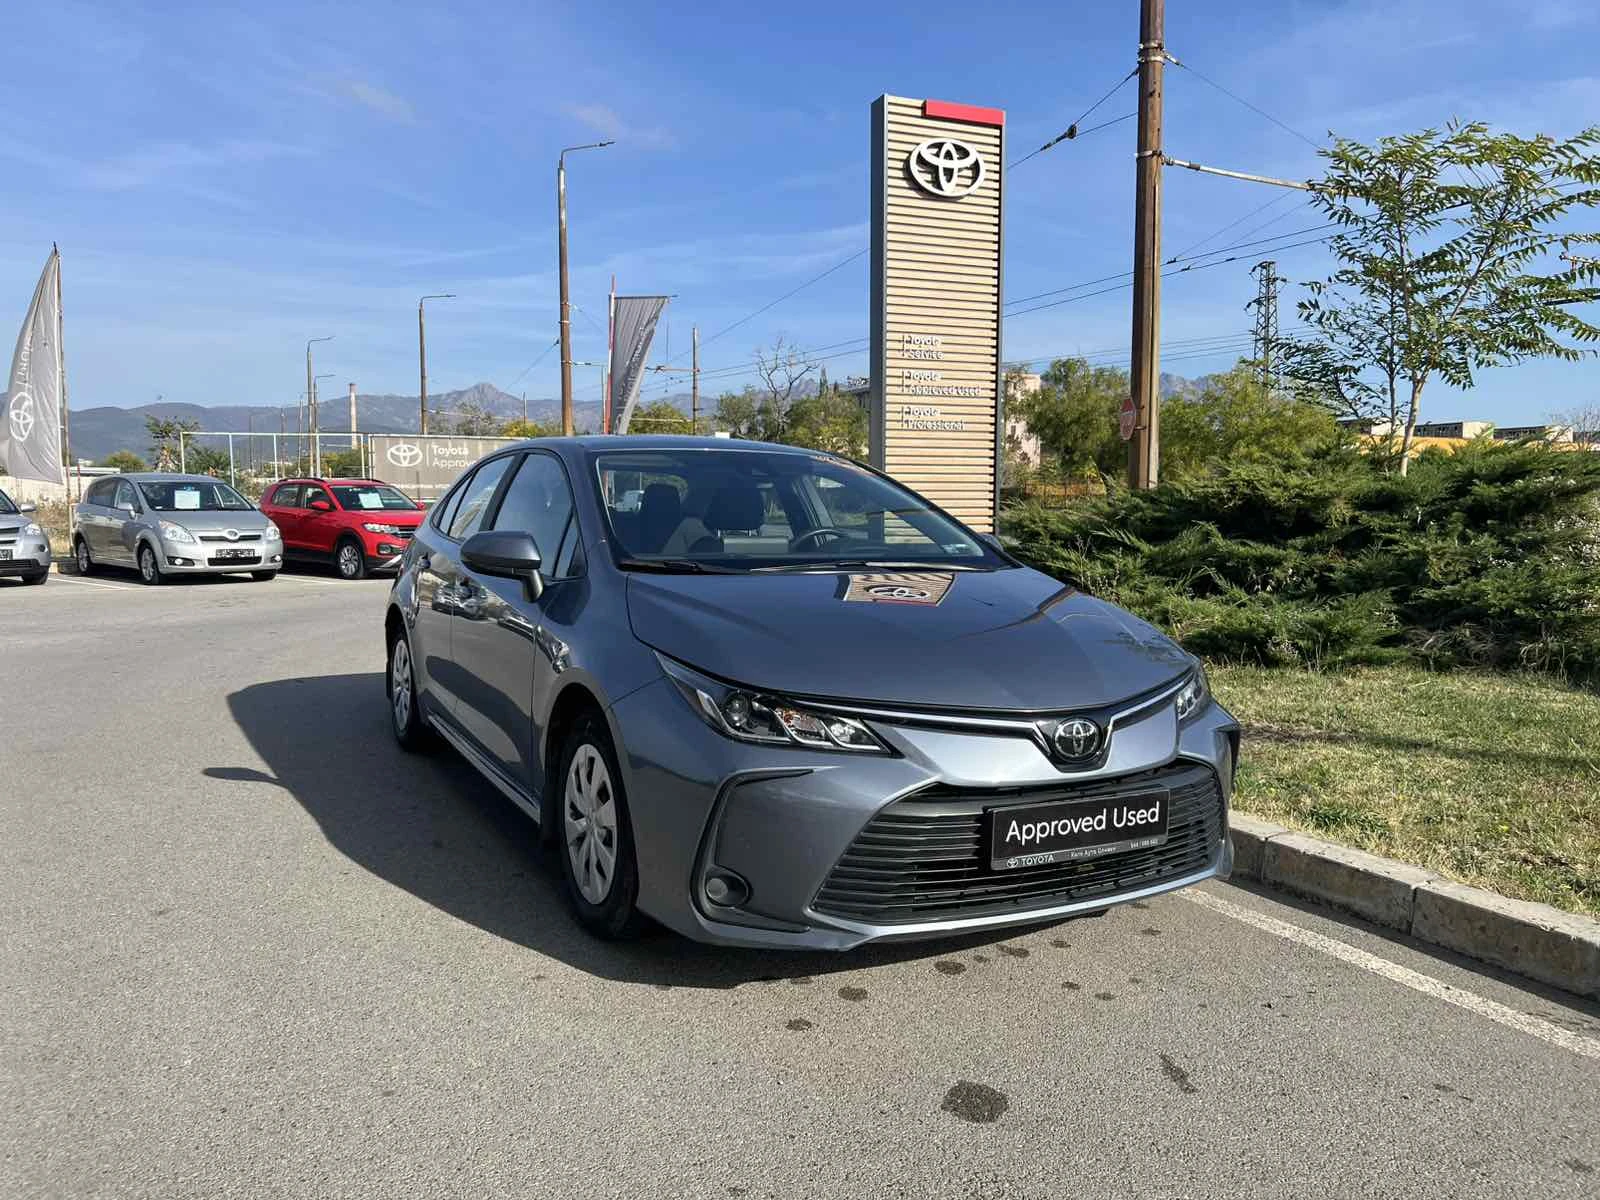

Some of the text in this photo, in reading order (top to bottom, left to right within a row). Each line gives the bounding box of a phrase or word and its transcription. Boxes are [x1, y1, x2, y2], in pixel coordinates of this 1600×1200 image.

[431, 444, 469, 457] Toyota
[432, 457, 474, 470] Approv
[1005, 801, 1160, 846] Approved Used
[1021, 854, 1054, 865] TOYOTA
